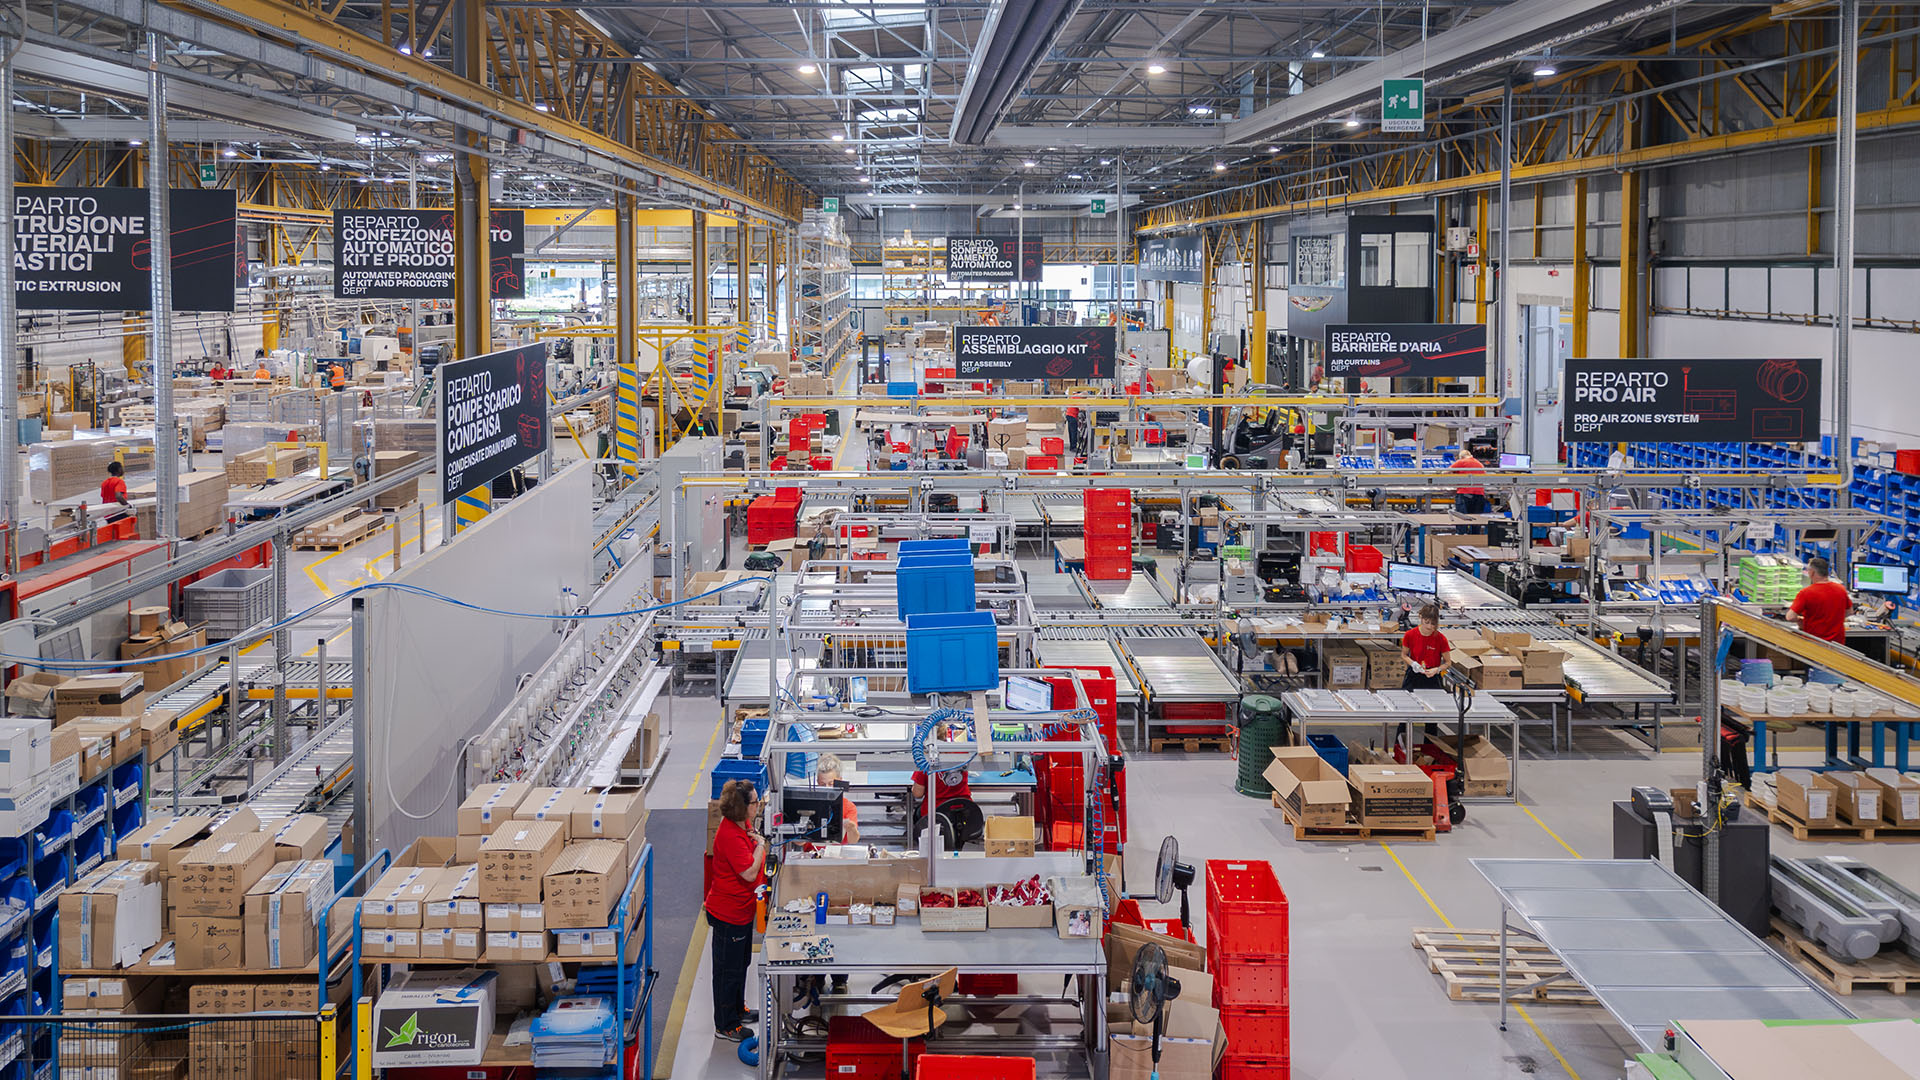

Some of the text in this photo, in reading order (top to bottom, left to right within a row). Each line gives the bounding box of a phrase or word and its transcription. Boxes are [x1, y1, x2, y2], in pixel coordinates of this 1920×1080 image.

[16, 197, 98, 216] PARTO
[14, 215, 145, 235] TRUSIONE
[343, 215, 420, 229] REPARTO
[15, 234, 114, 253] TERIALI
[342, 241, 454, 254] AUTOMATICO
[951, 239, 994, 247] REPARTO
[950, 246, 999, 255] CONFEZIO
[15, 252, 92, 272] ASTICI
[343, 254, 455, 266] KIT E PRODOT
[342, 271, 401, 279] AUTOMATED
[39, 281, 121, 292] EXTRUSION
[342, 279, 356, 287] OF
[396, 279, 449, 287] PRODUCTS
[342, 287, 367, 295] DEPT
[962, 334, 1021, 345] REPARTO
[1331, 332, 1391, 343] REPARTO
[961, 344, 1088, 355] ASSEMBLAGGIO KIT
[1331, 342, 1442, 353] BARRIERE D'ARIA
[1576, 372, 1669, 387] REPARTO
[447, 370, 492, 404] REPARTO
[1575, 387, 1657, 402] PRO AIR
[447, 383, 521, 429] POMPE SCARICO
[1574, 414, 1699, 423] PRO AIR ZONE SYSTEM
[447, 413, 501, 454] CONDENSA
[1574, 423, 1603, 432] DEPT
[447, 433, 517, 477] CONDENSATE DRAIN PUMPS
[447, 472, 463, 492] DEPT
